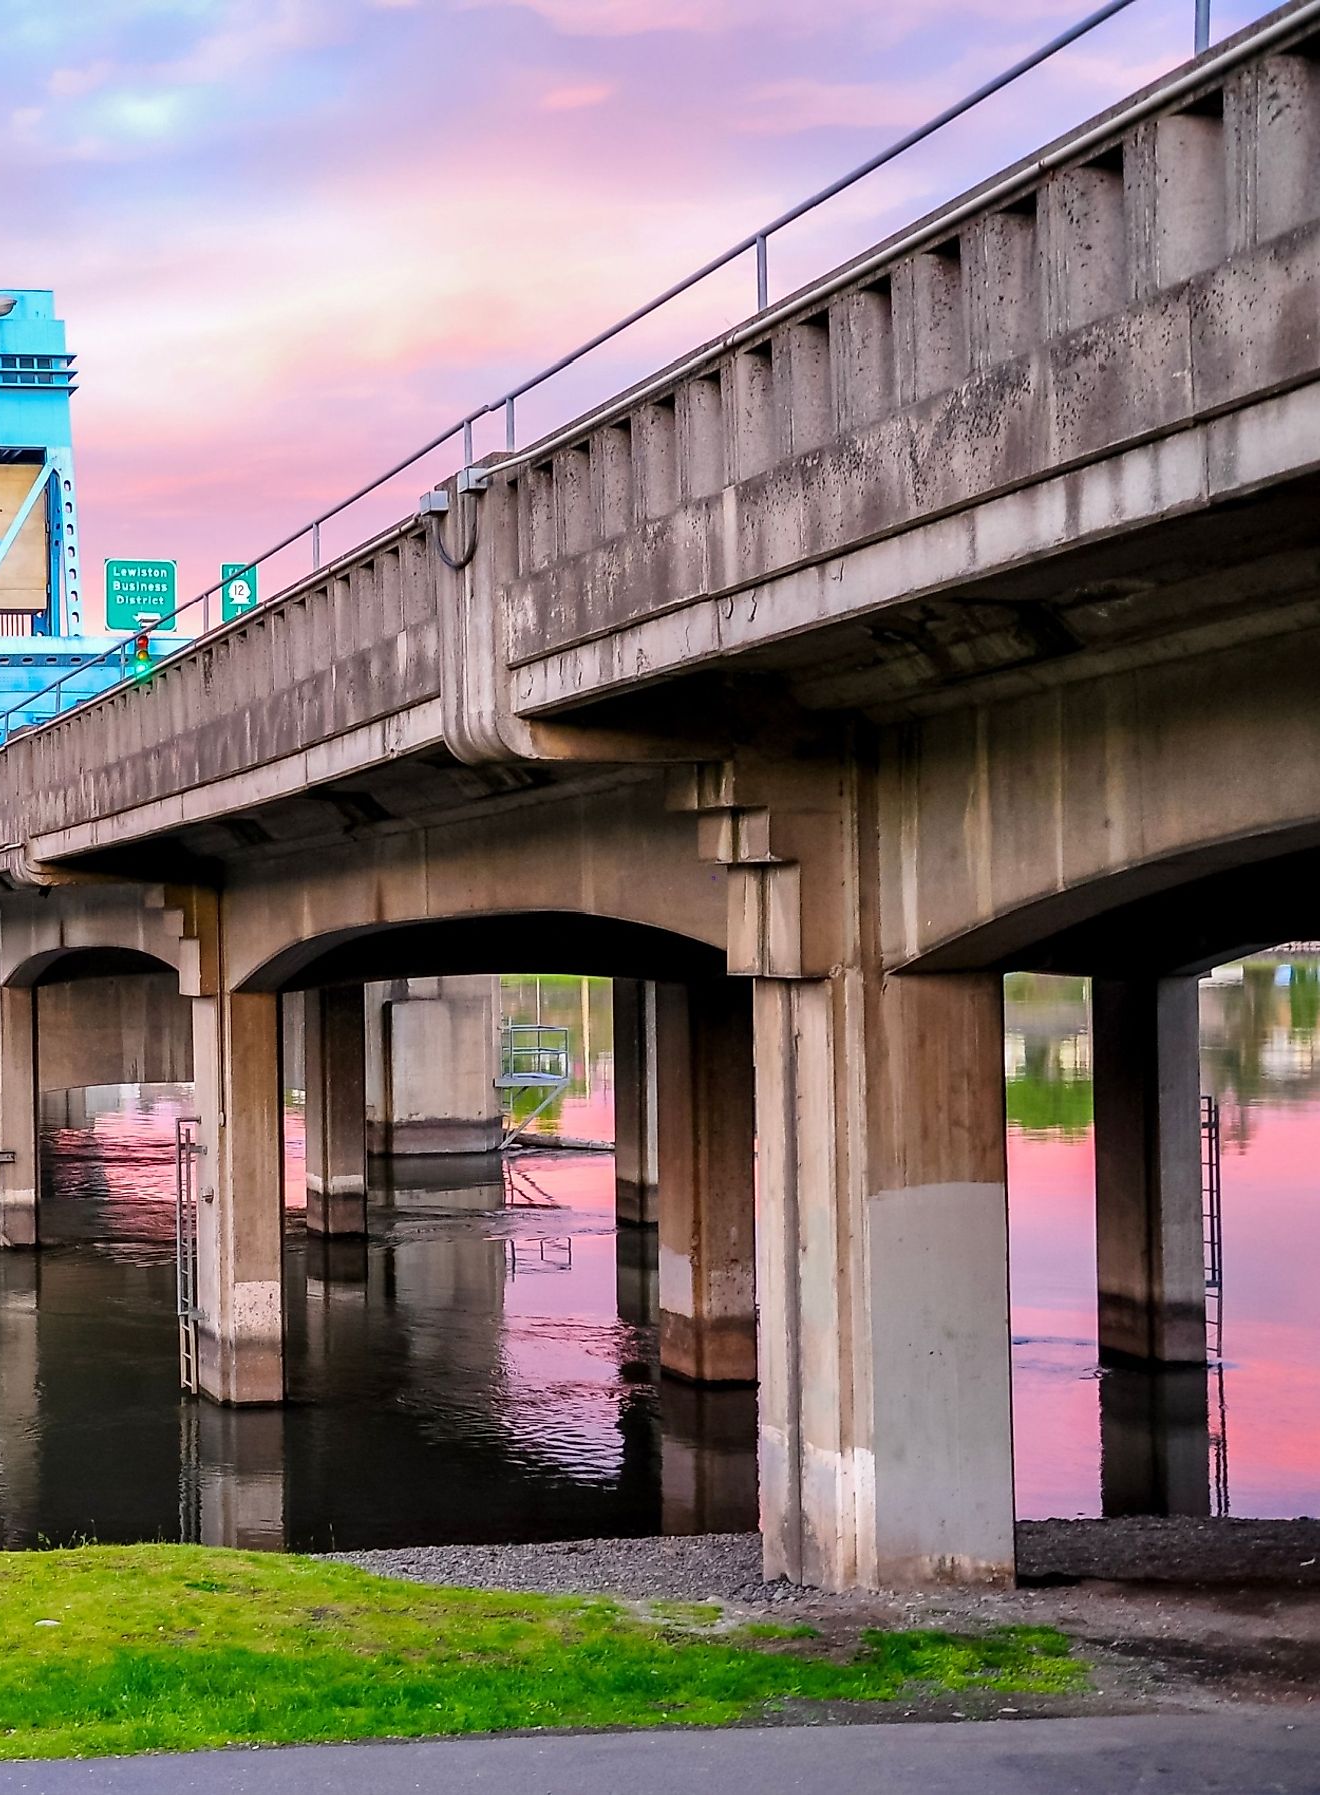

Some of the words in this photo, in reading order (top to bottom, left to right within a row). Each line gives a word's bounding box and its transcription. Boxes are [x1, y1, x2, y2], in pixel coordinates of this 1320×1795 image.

[113, 566, 167, 577] Lewiston
[113, 581, 168, 592] Business
[234, 585, 245, 596] 12
[116, 595, 165, 605] District
